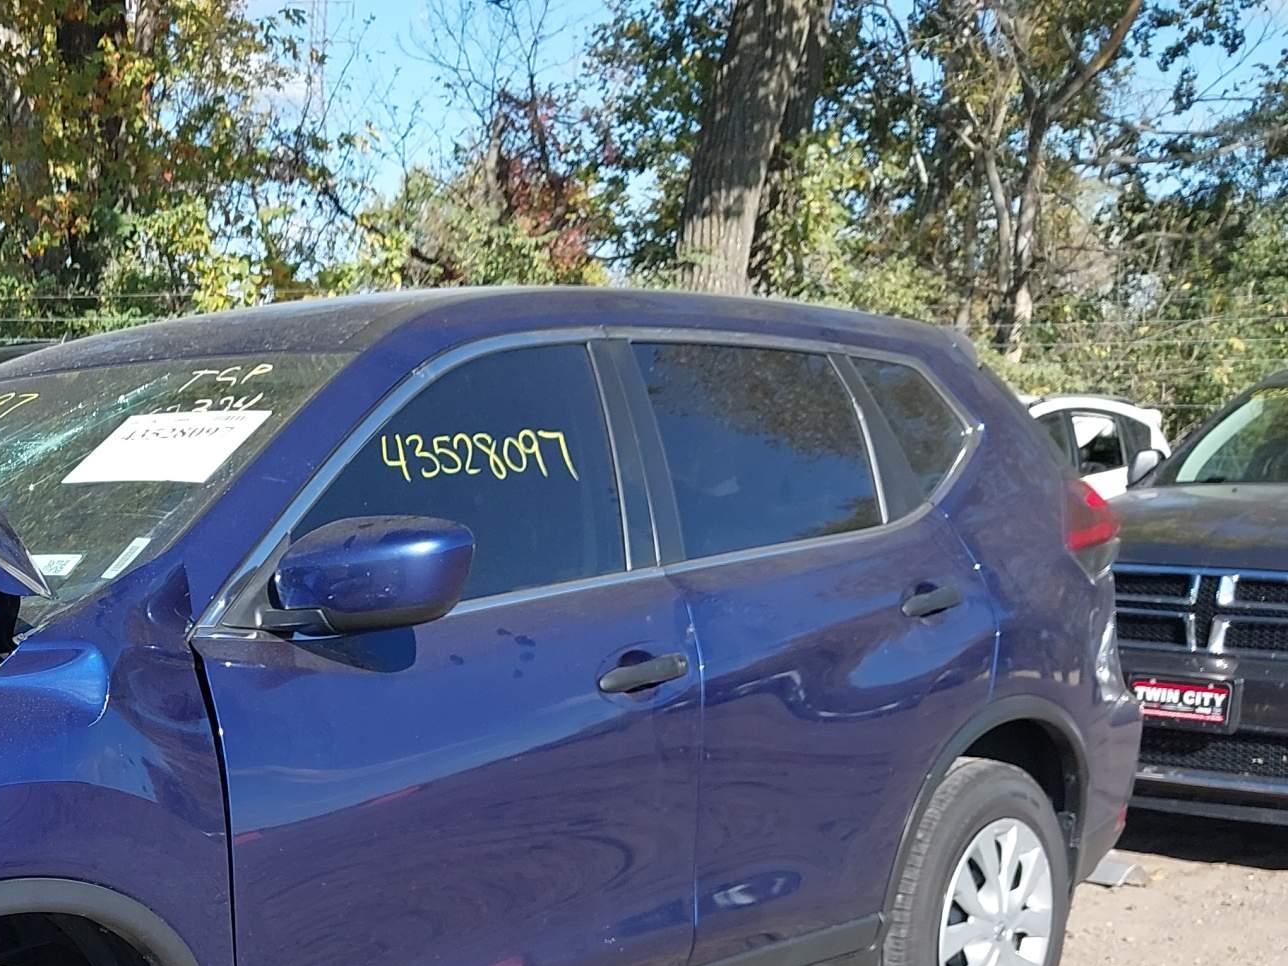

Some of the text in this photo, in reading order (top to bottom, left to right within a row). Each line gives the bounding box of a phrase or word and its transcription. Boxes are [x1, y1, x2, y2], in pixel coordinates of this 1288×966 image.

[381, 429, 579, 482] 43528097
[1133, 685, 1227, 708] TWIN CITY
